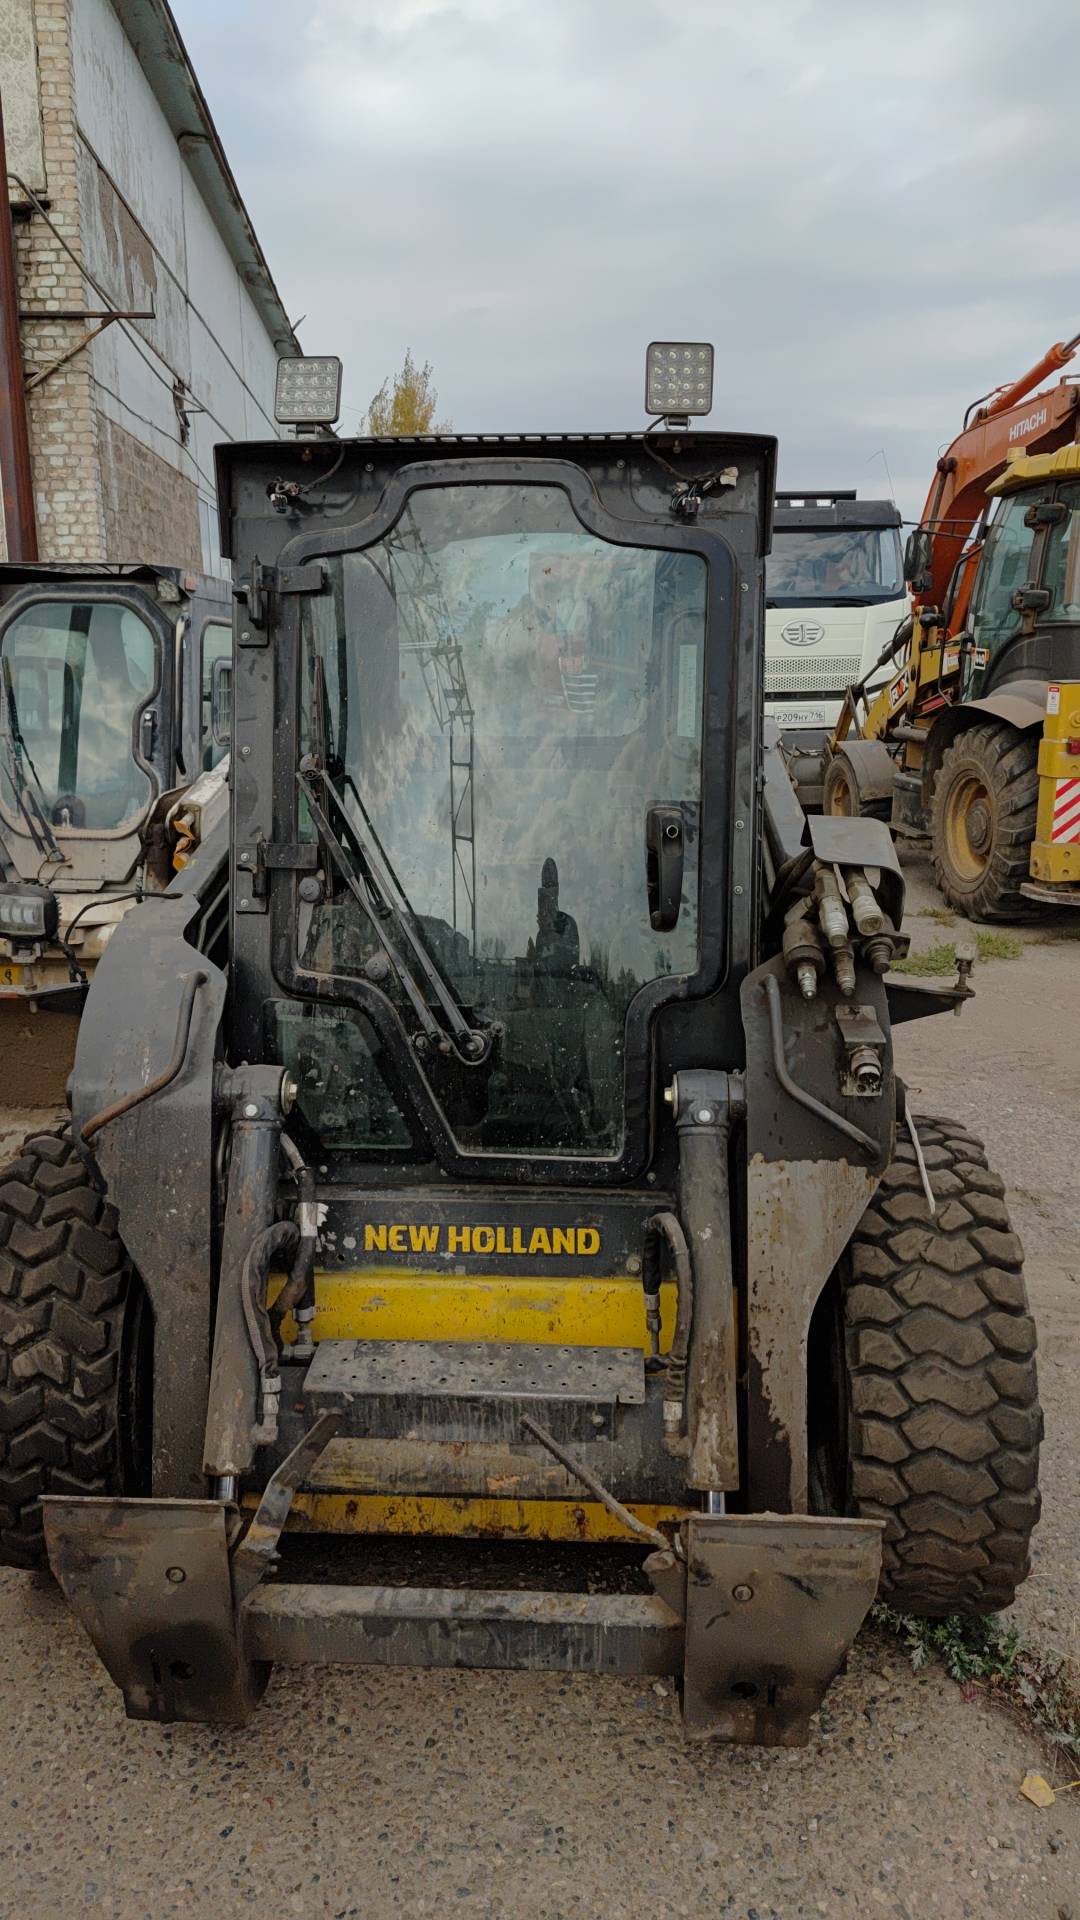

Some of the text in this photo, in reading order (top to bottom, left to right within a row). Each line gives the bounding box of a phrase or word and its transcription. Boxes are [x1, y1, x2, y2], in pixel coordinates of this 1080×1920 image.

[1009, 408, 1047, 442] HITACHI
[364, 1224, 601, 1255] NEW HOLLAND
